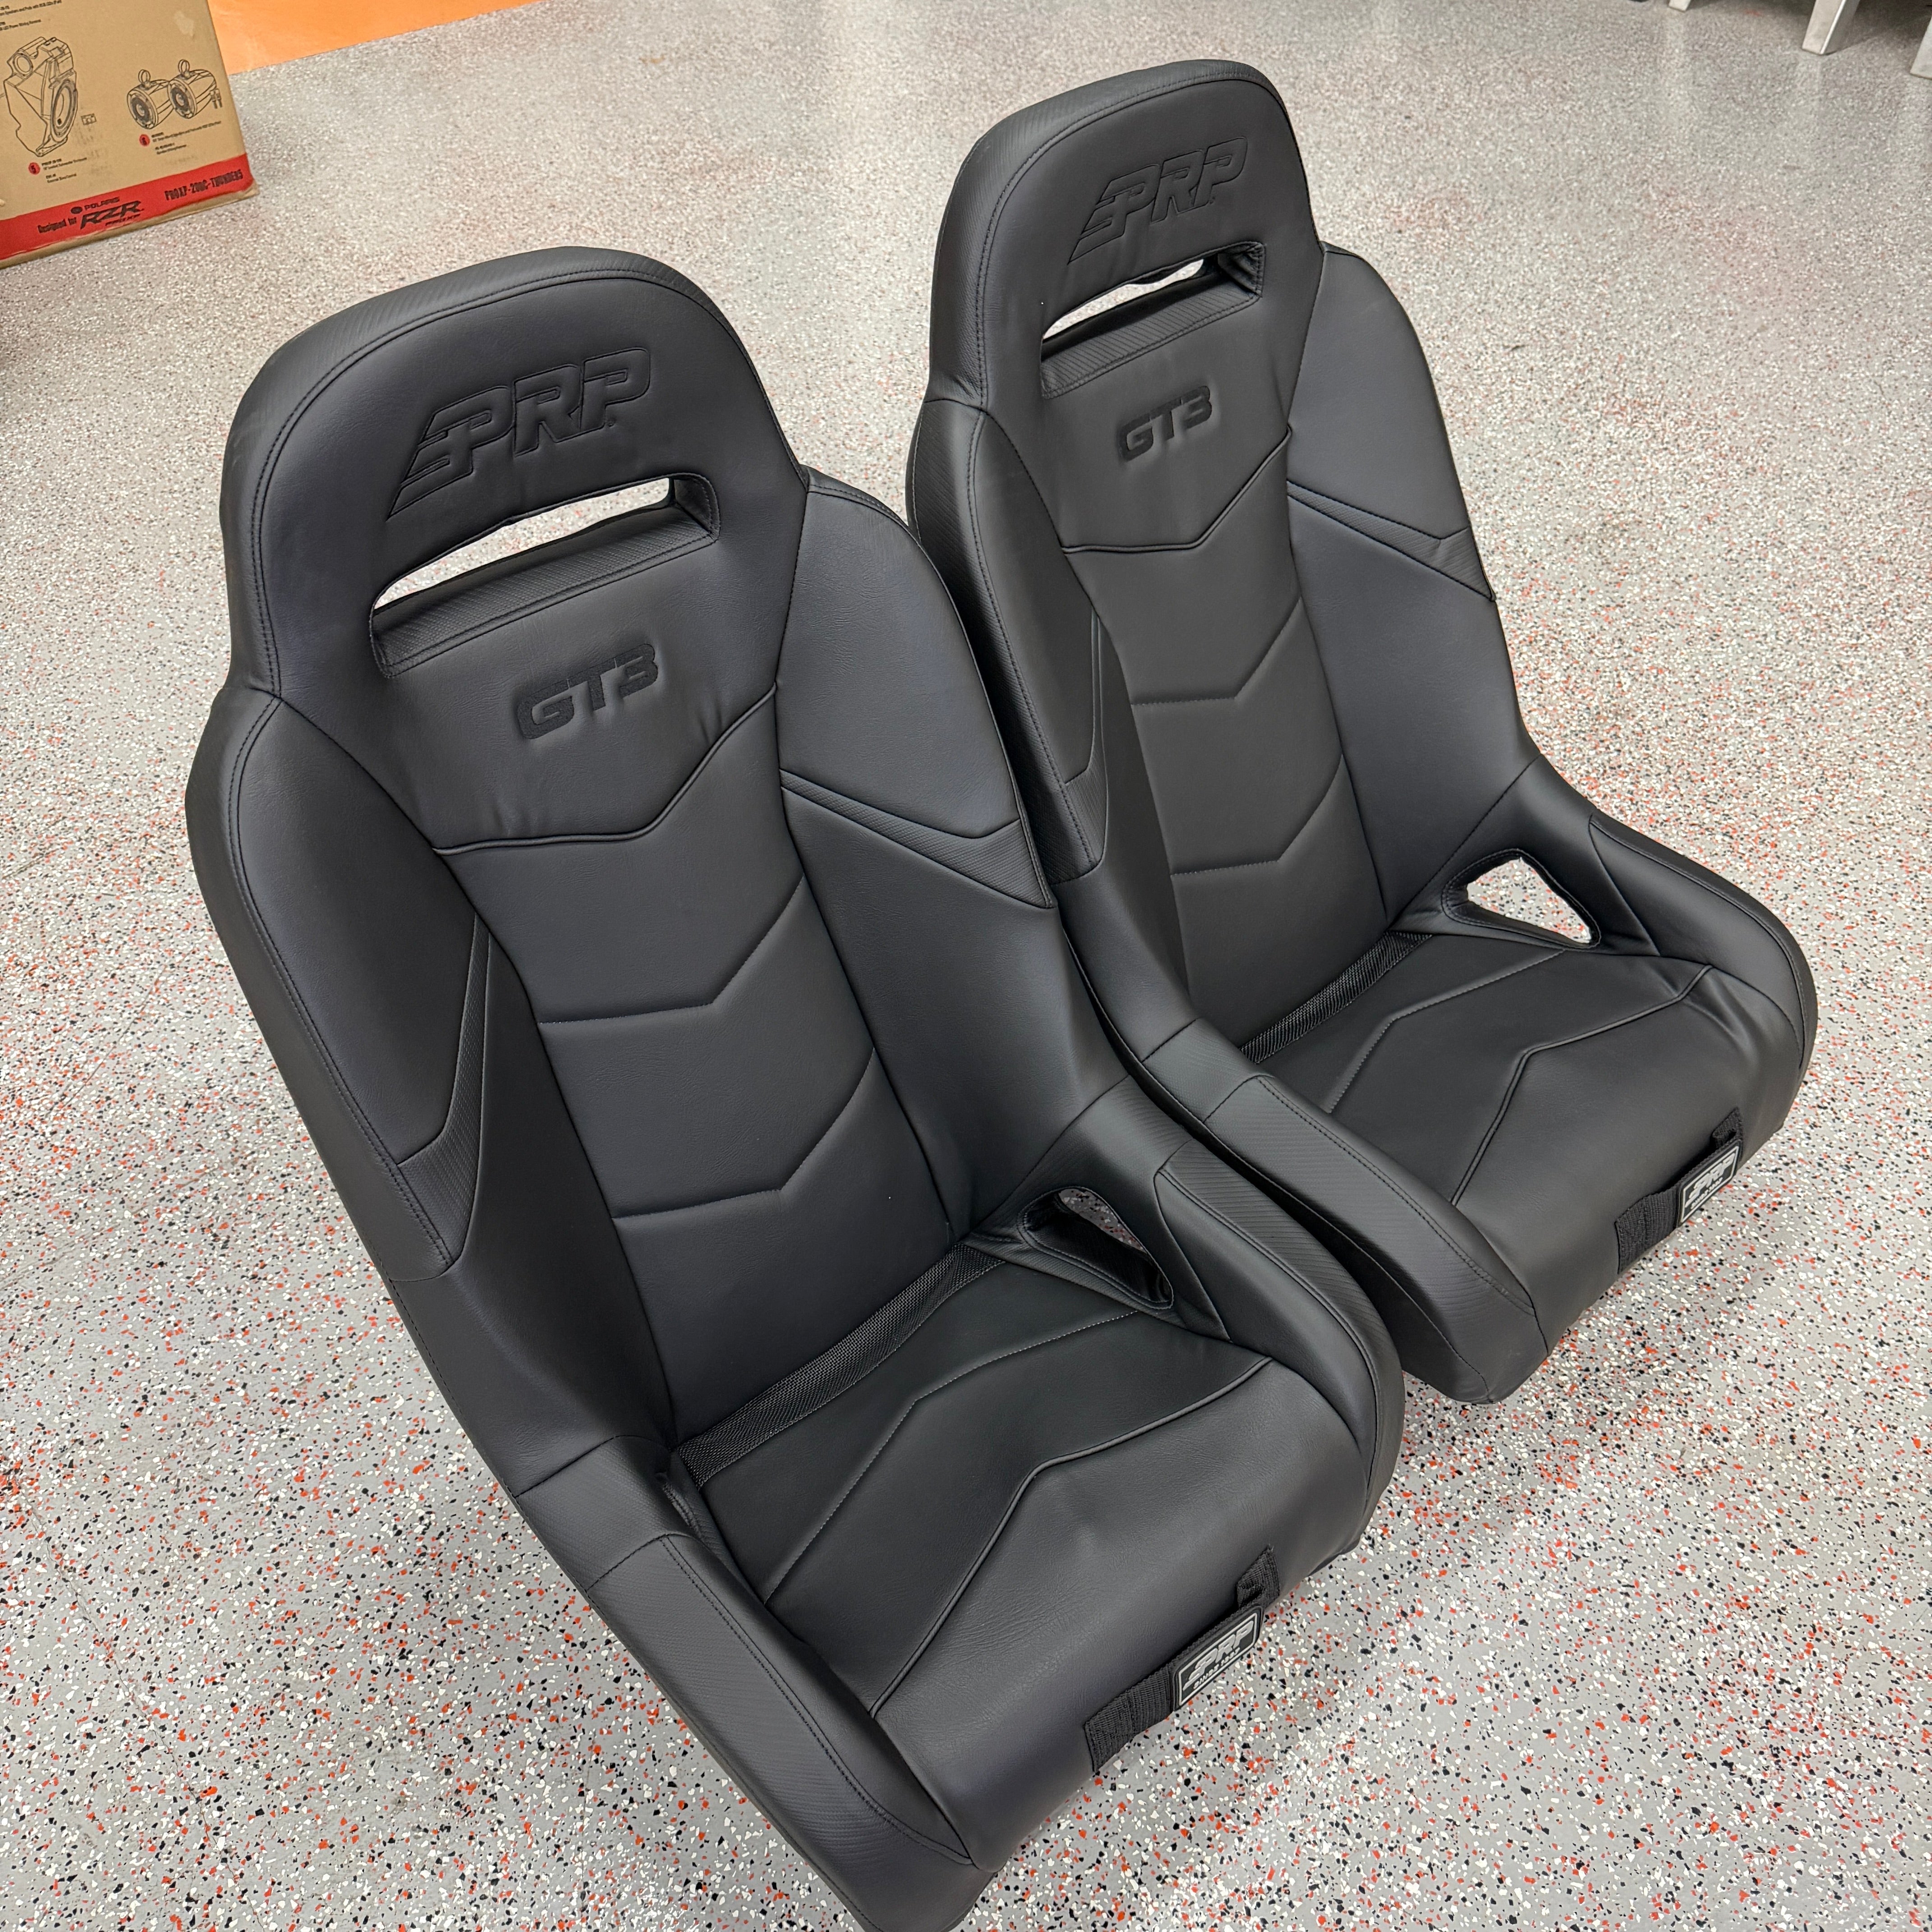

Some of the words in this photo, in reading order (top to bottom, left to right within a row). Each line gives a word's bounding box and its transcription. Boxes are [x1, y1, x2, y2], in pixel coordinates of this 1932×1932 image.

[80, 200, 142, 230] RZR
[1118, 386, 1212, 463] GT3
[517, 644, 658, 740] GT3
